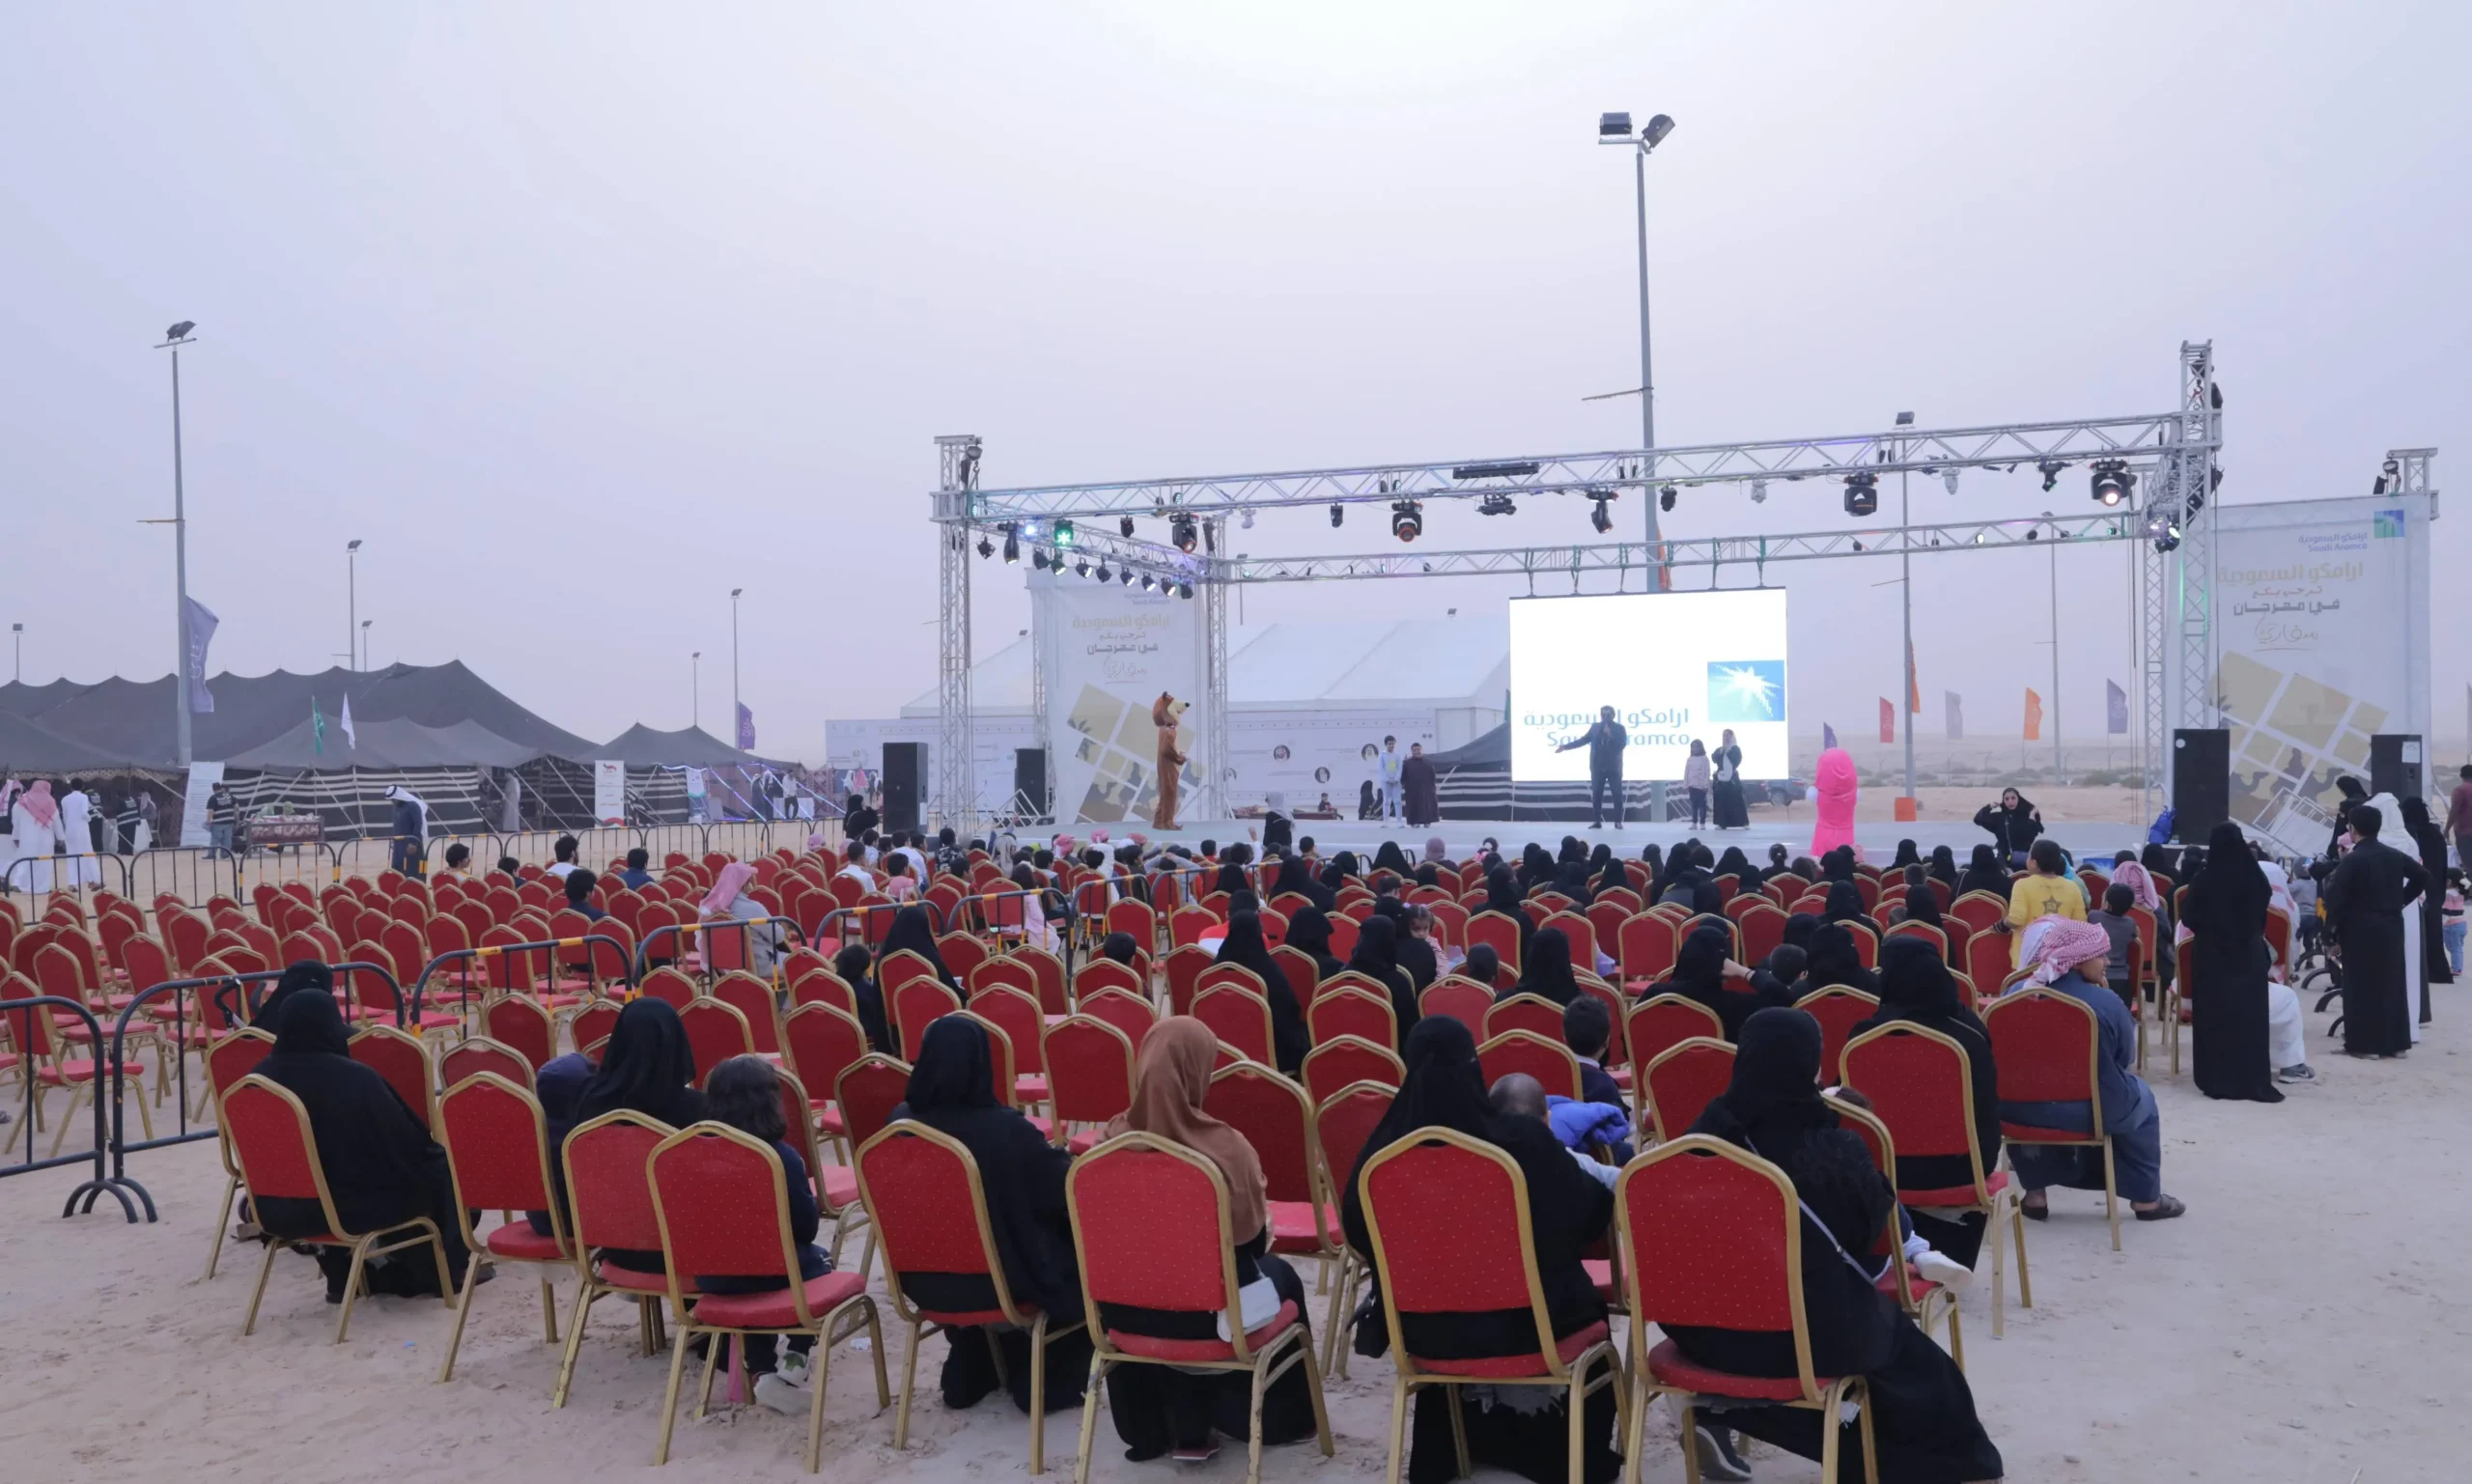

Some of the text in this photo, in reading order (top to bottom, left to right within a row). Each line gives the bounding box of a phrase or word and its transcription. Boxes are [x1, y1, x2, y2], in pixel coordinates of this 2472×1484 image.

[2233, 598, 2341, 616] في مهرجان
[1524, 708, 1689, 731] ارامكو اسعودية
[1626, 733, 1690, 745] ramco
